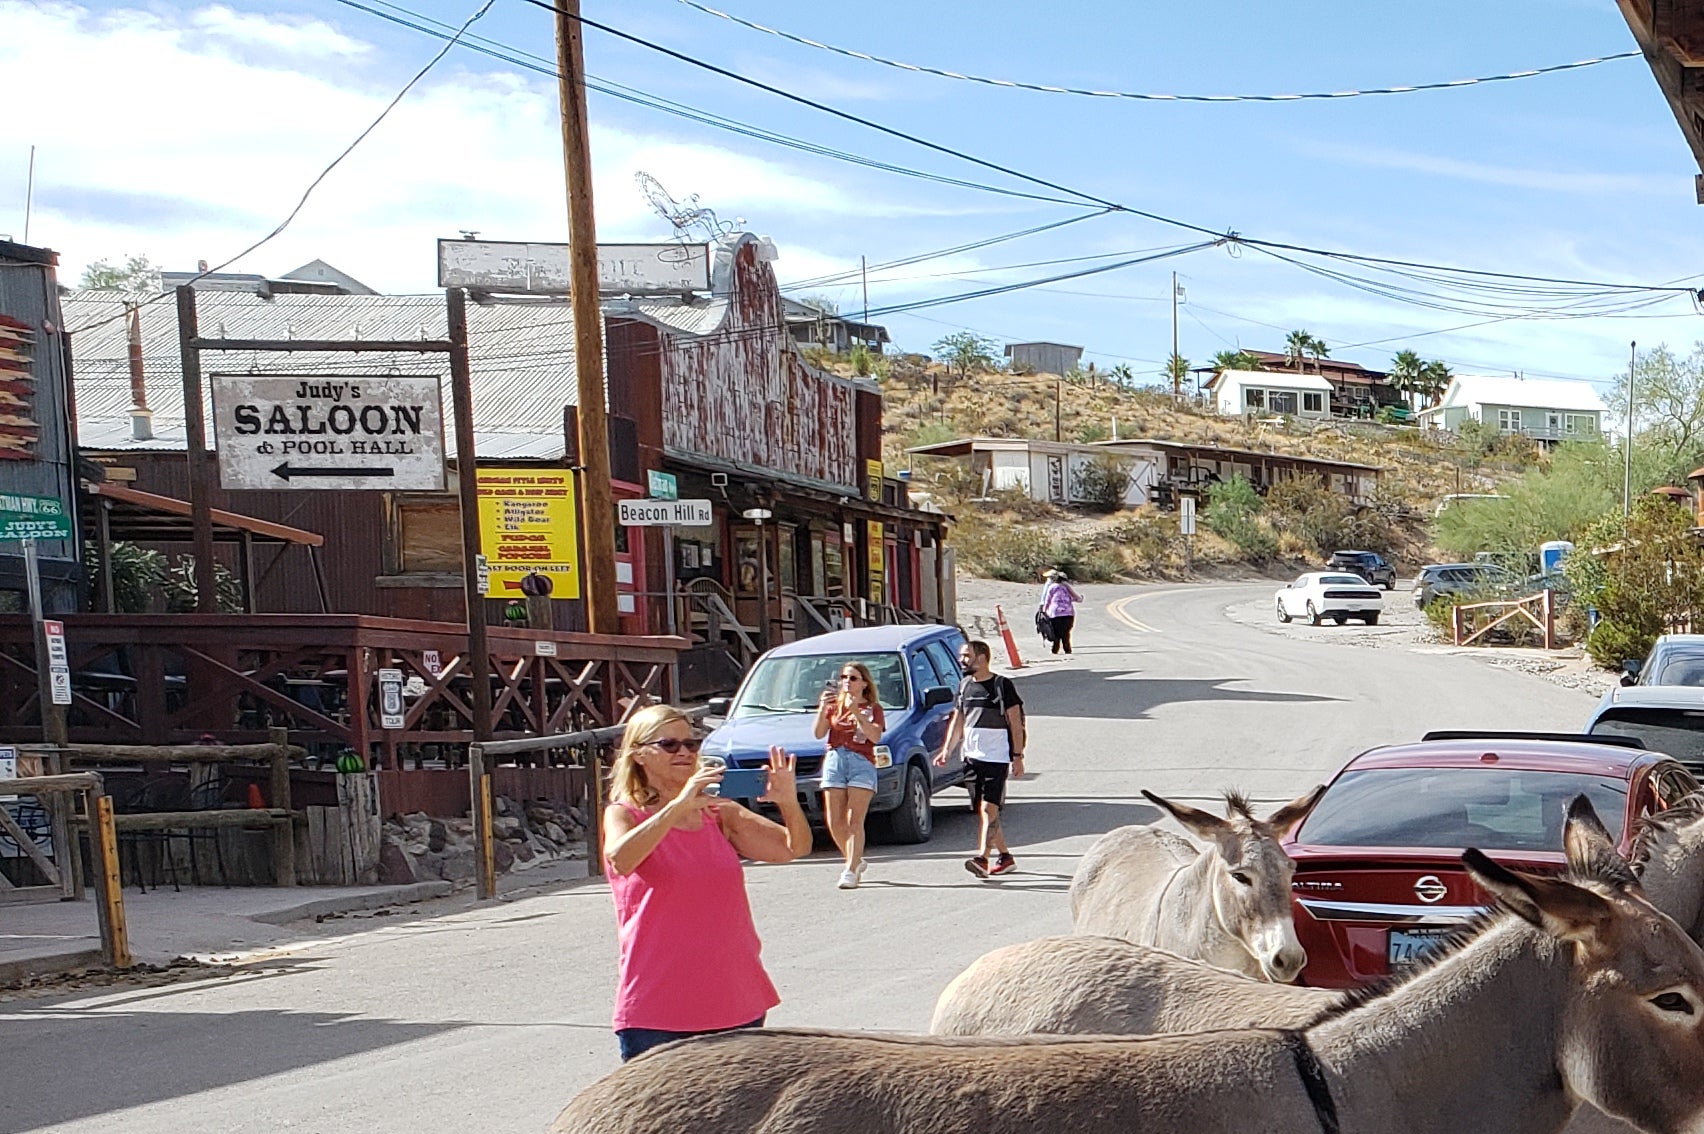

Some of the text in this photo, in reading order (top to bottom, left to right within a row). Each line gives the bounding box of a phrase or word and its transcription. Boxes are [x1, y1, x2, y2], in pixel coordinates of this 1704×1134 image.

[296, 381, 361, 402] Judy's
[234, 404, 424, 435] SALOON
[256, 440, 414, 455] & POOL HALL
[42, 505, 59, 514] 66
[503, 500, 549, 508] Kangaroo
[621, 504, 710, 521] Beacon Hill Rd
[425, 654, 437, 663] NO
